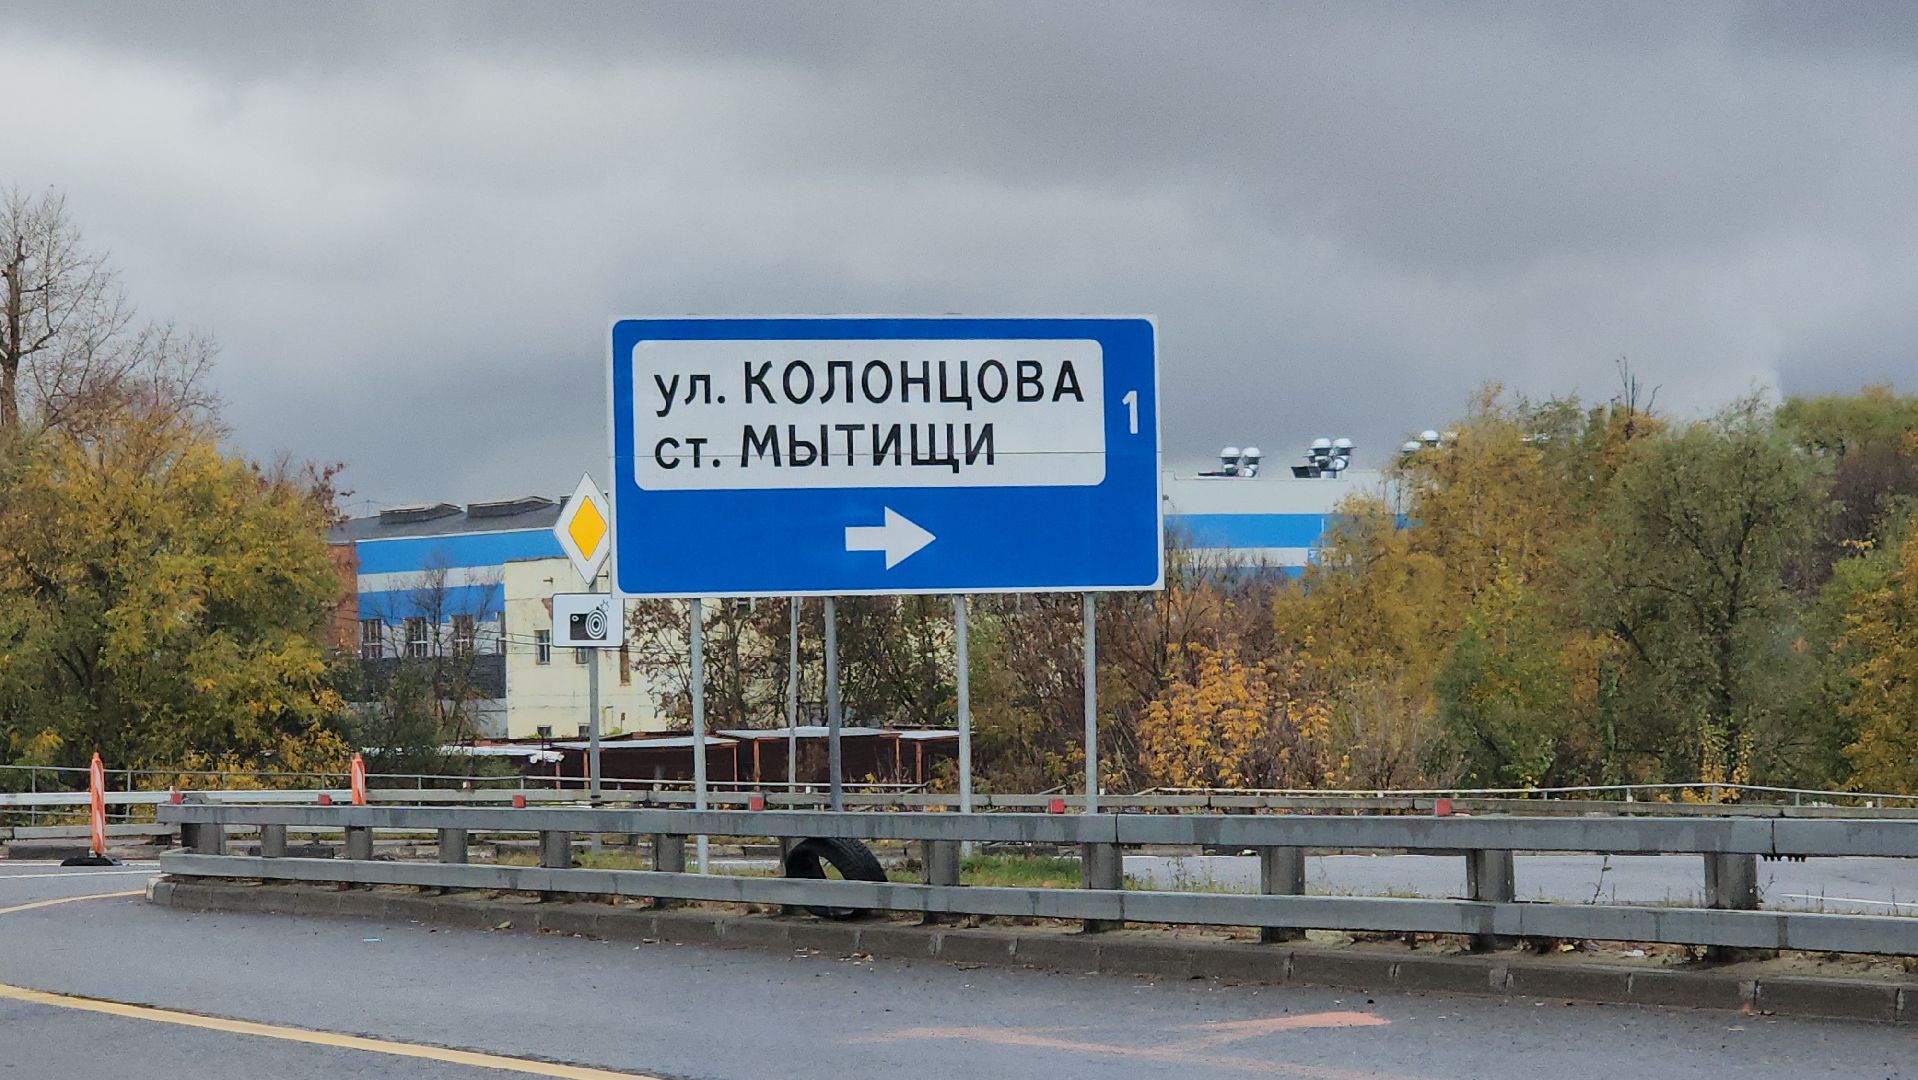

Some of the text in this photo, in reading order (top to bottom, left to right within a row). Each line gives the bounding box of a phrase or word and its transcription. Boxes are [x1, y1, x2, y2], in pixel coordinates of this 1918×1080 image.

[654, 360, 1084, 417] ул. КОЛОНЦОВА
[1122, 390, 1138, 434] 1
[655, 423, 994, 473] ст. МЫТИЩИ
